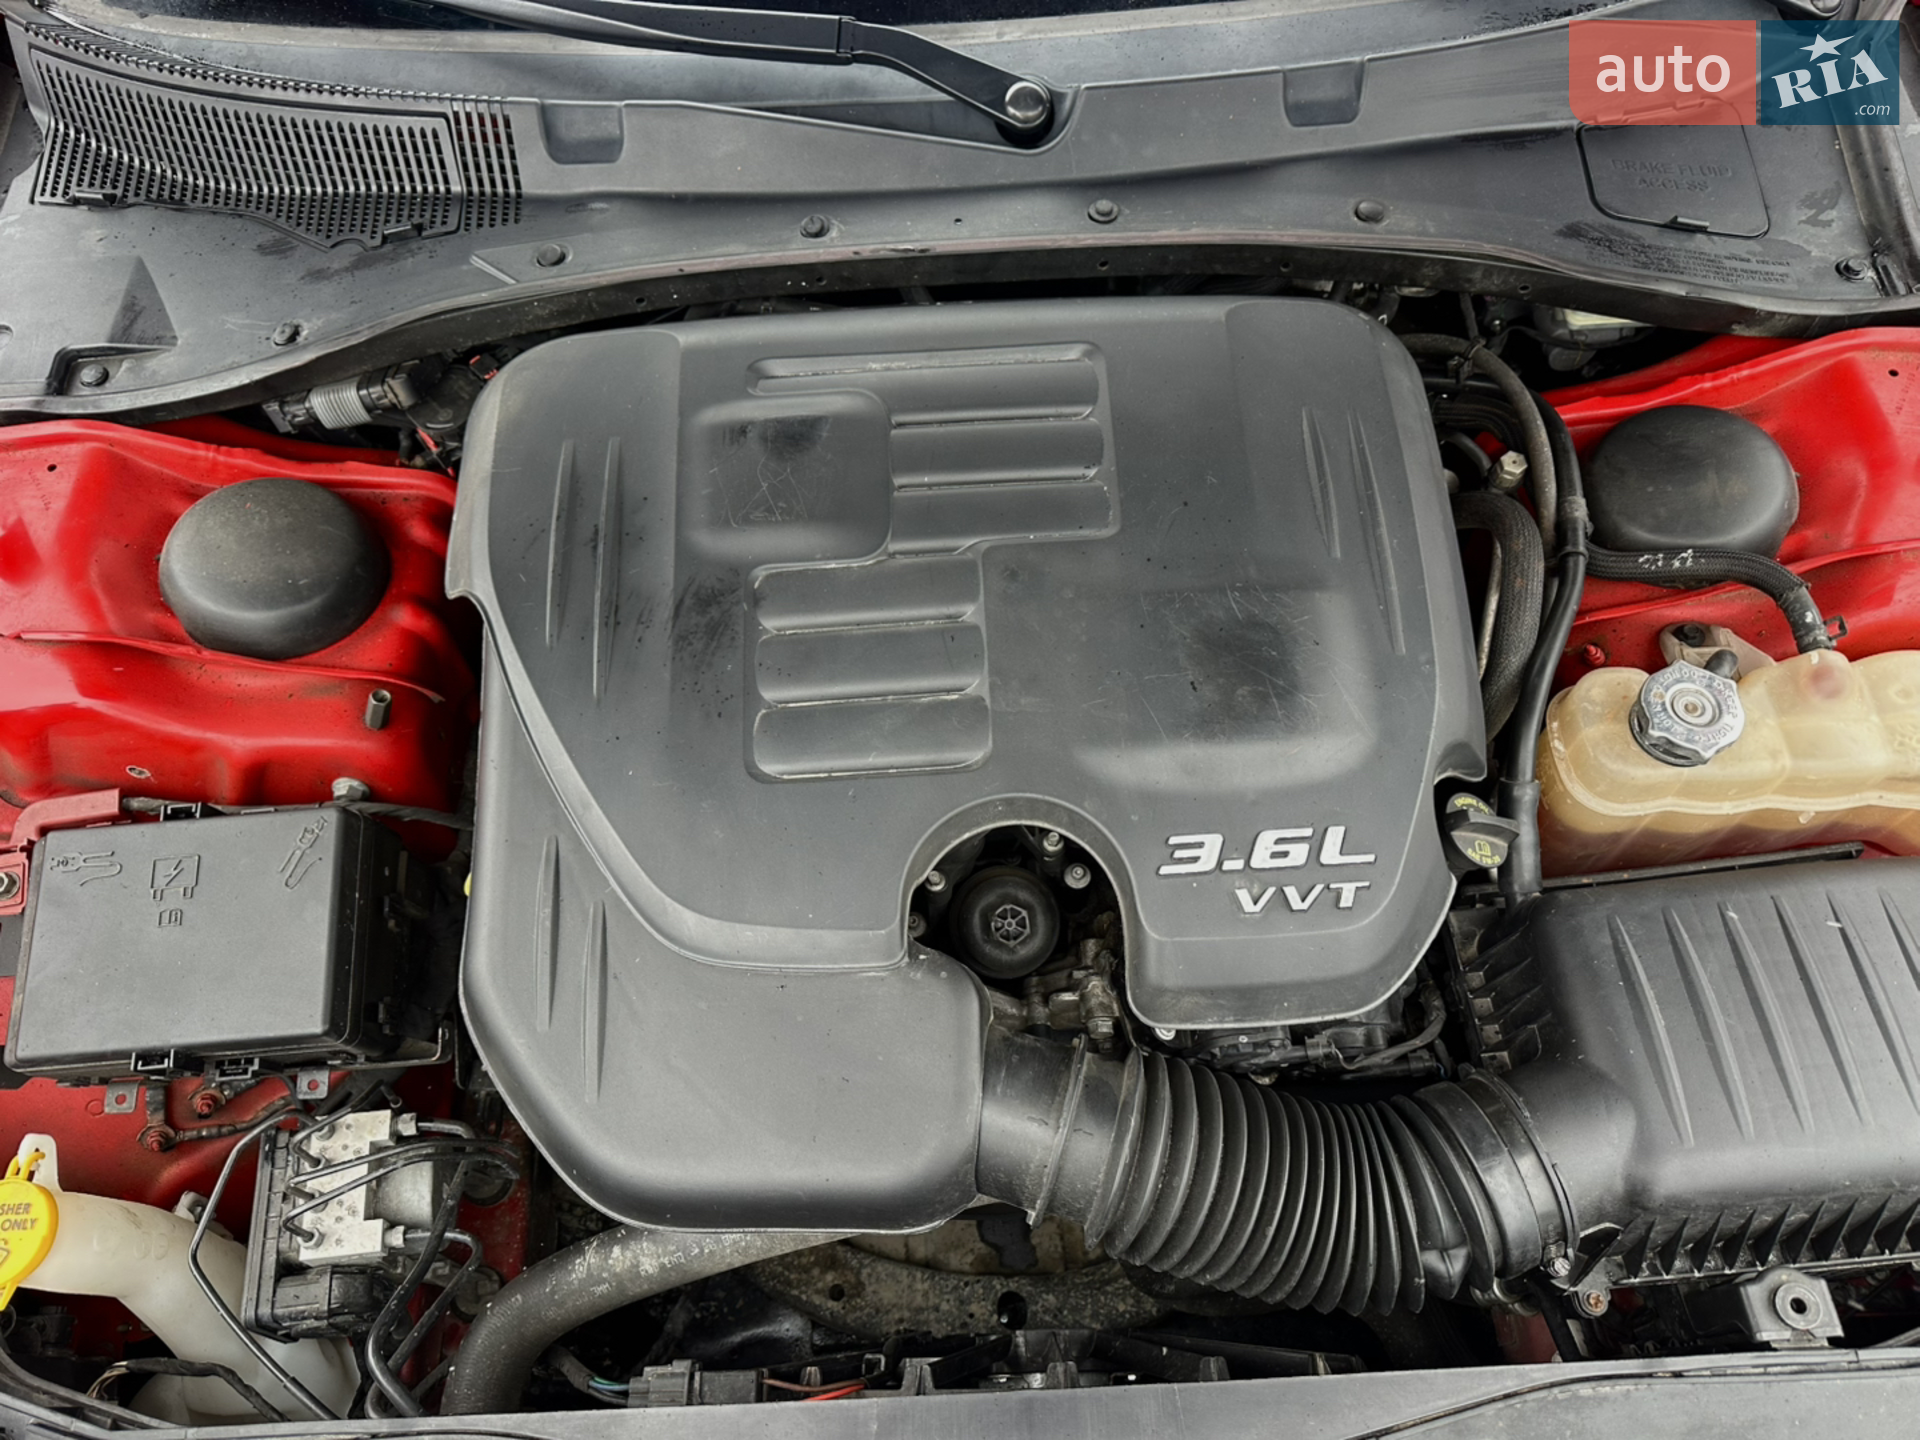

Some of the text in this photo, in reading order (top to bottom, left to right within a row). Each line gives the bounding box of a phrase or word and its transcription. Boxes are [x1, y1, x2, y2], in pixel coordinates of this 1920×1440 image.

[1610, 159, 1732, 178] BRAKE FLUID
[1638, 178, 1711, 192] ACCESS
[1156, 825, 1377, 877] 3.6L
[1234, 880, 1371, 915] VVT
[1, 1218, 37, 1231] ONLY
